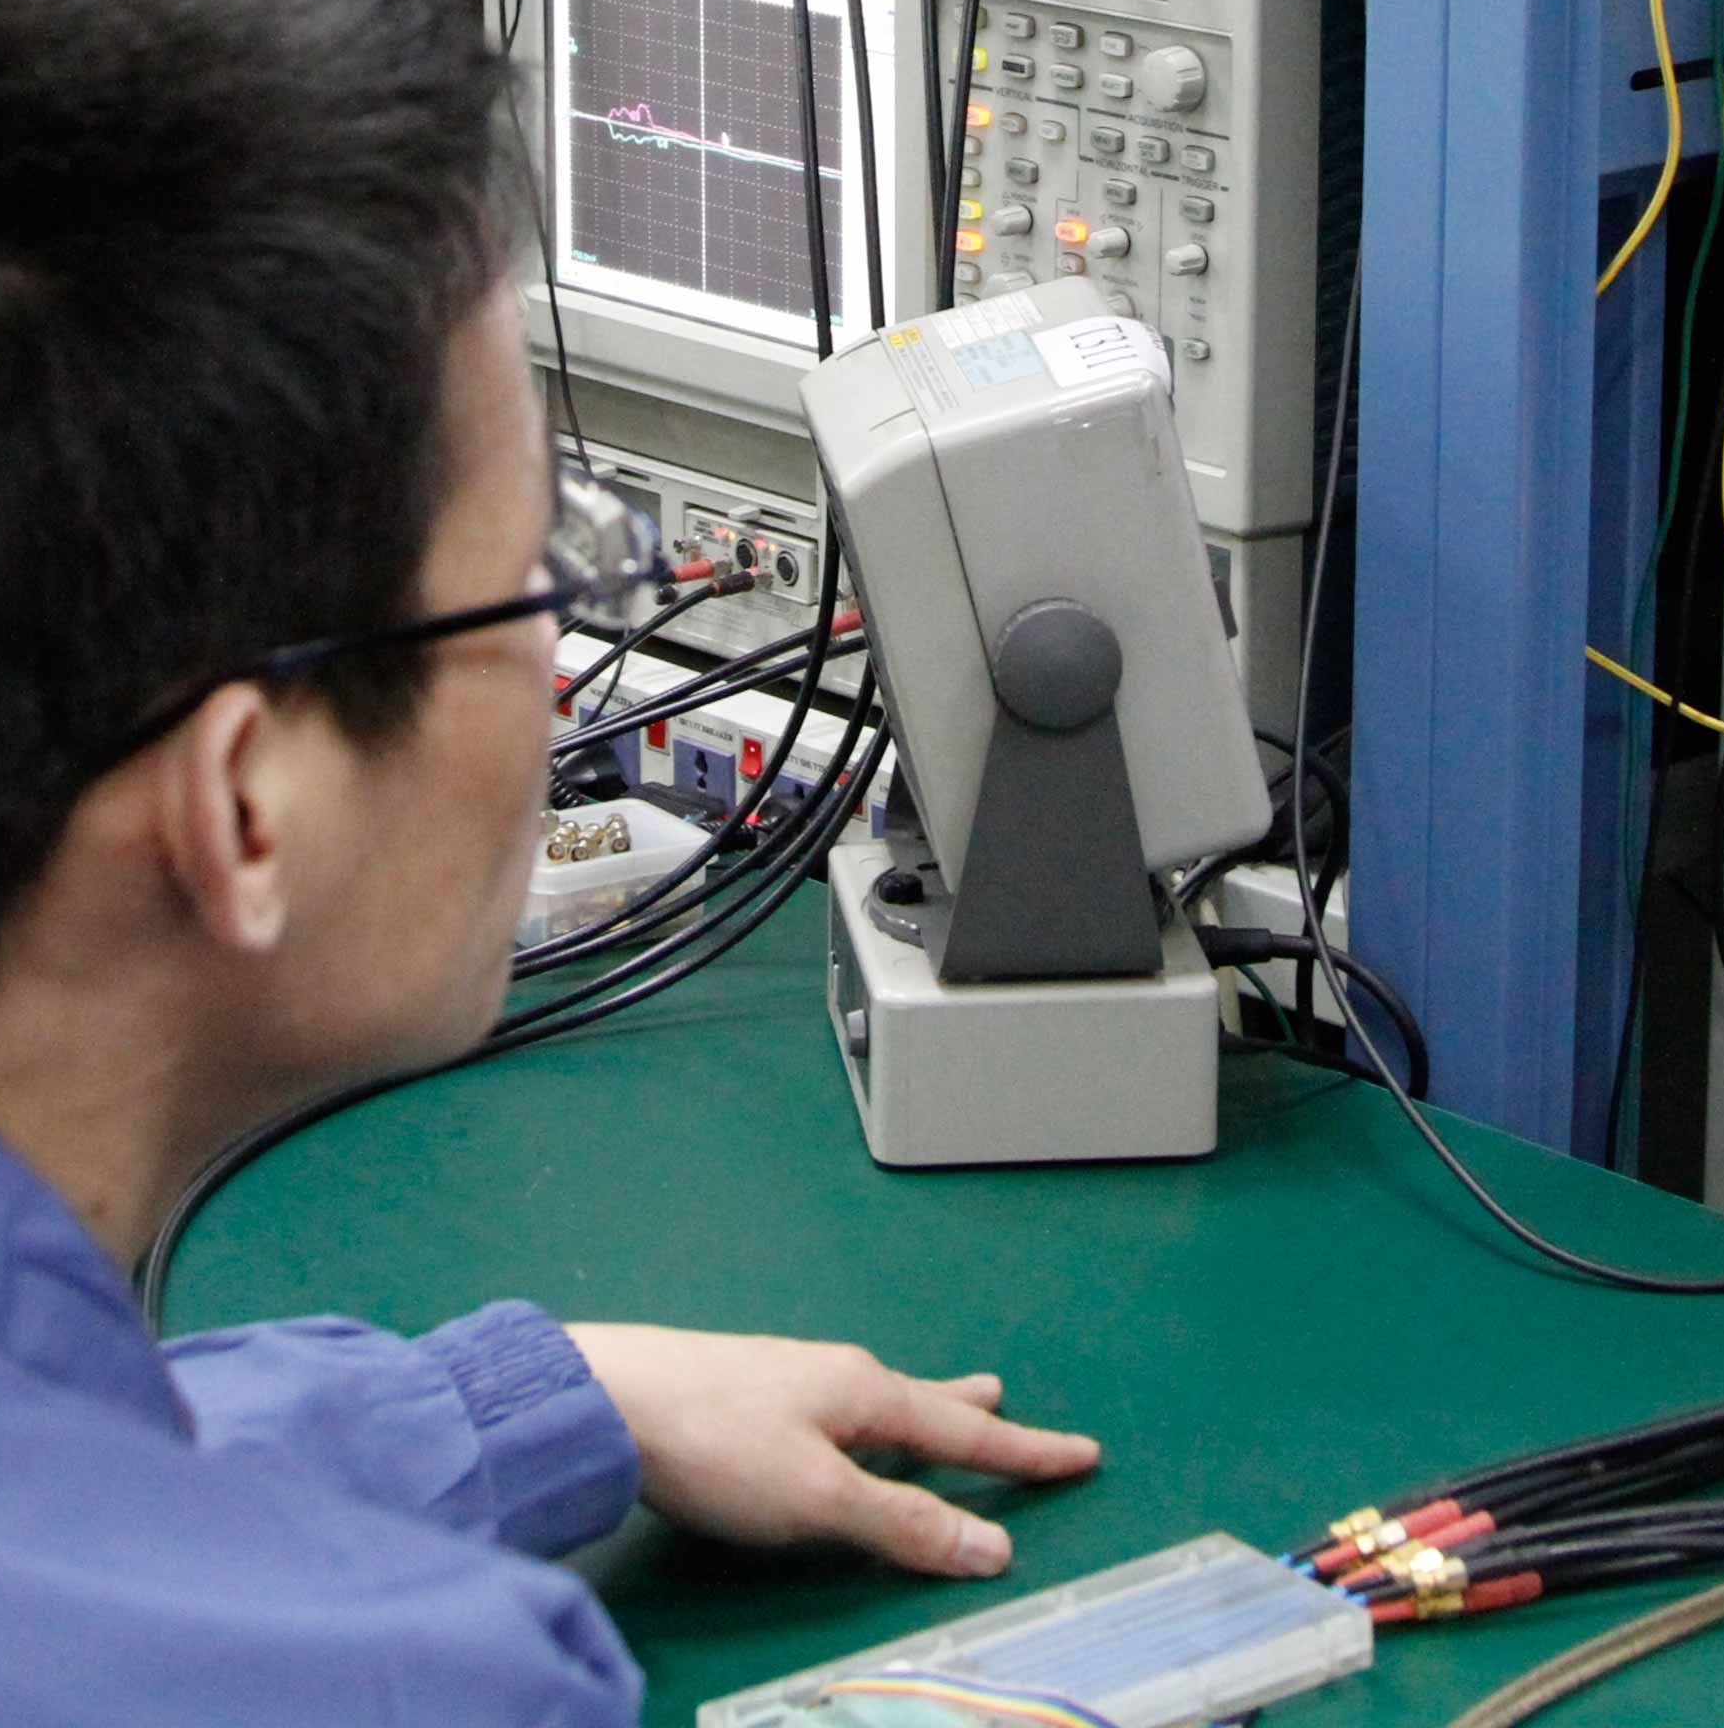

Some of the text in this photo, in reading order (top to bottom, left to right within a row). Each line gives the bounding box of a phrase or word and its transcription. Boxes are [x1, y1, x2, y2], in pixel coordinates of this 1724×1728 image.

[994, 87, 1033, 103] VERTICAL
[1128, 113, 1186, 134] ACQUISITION
[1094, 156, 1152, 177] HORIZONTAL
[1180, 173, 1220, 192] TRIGGER
